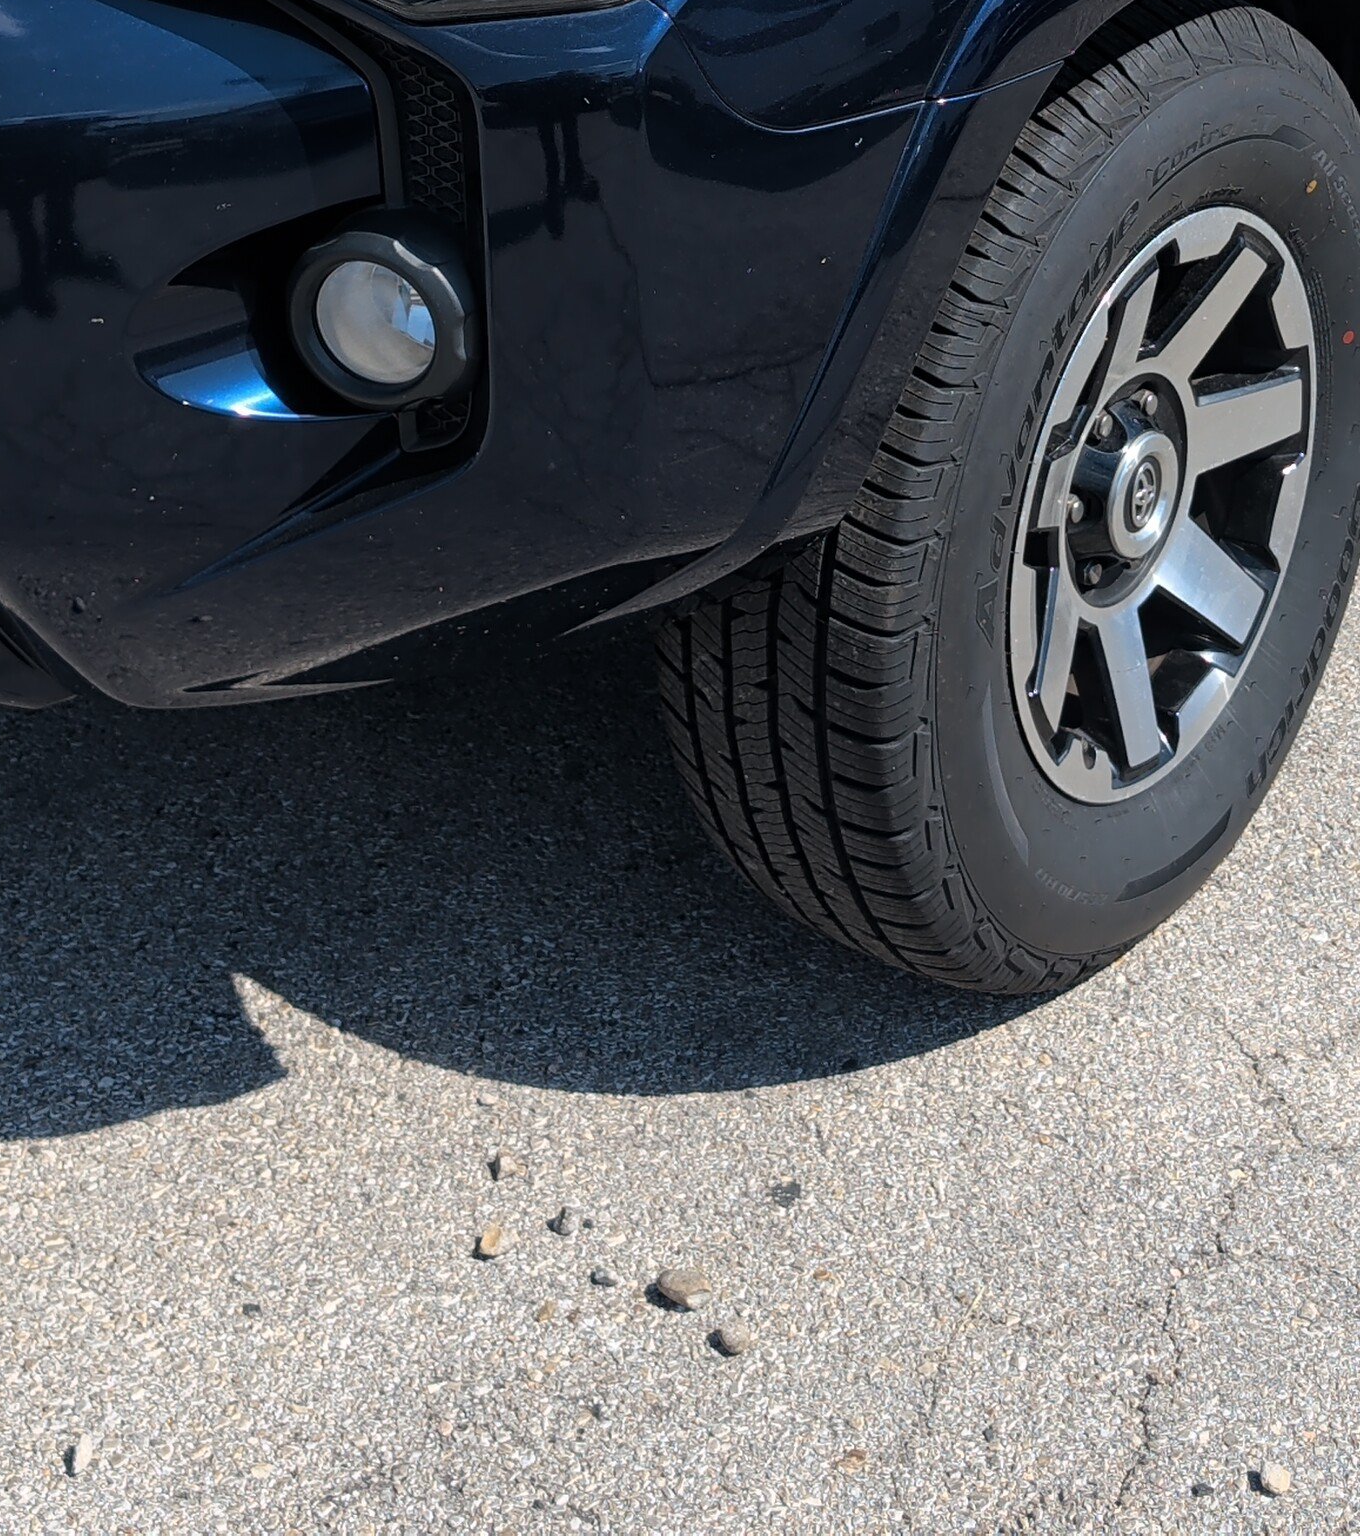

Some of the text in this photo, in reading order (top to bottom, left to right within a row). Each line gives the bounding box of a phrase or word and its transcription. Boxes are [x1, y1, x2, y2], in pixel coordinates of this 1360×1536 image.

[1311, 148, 1338, 179] All
[974, 197, 1142, 649] Advantage
[1152, 121, 1242, 188] Contro
